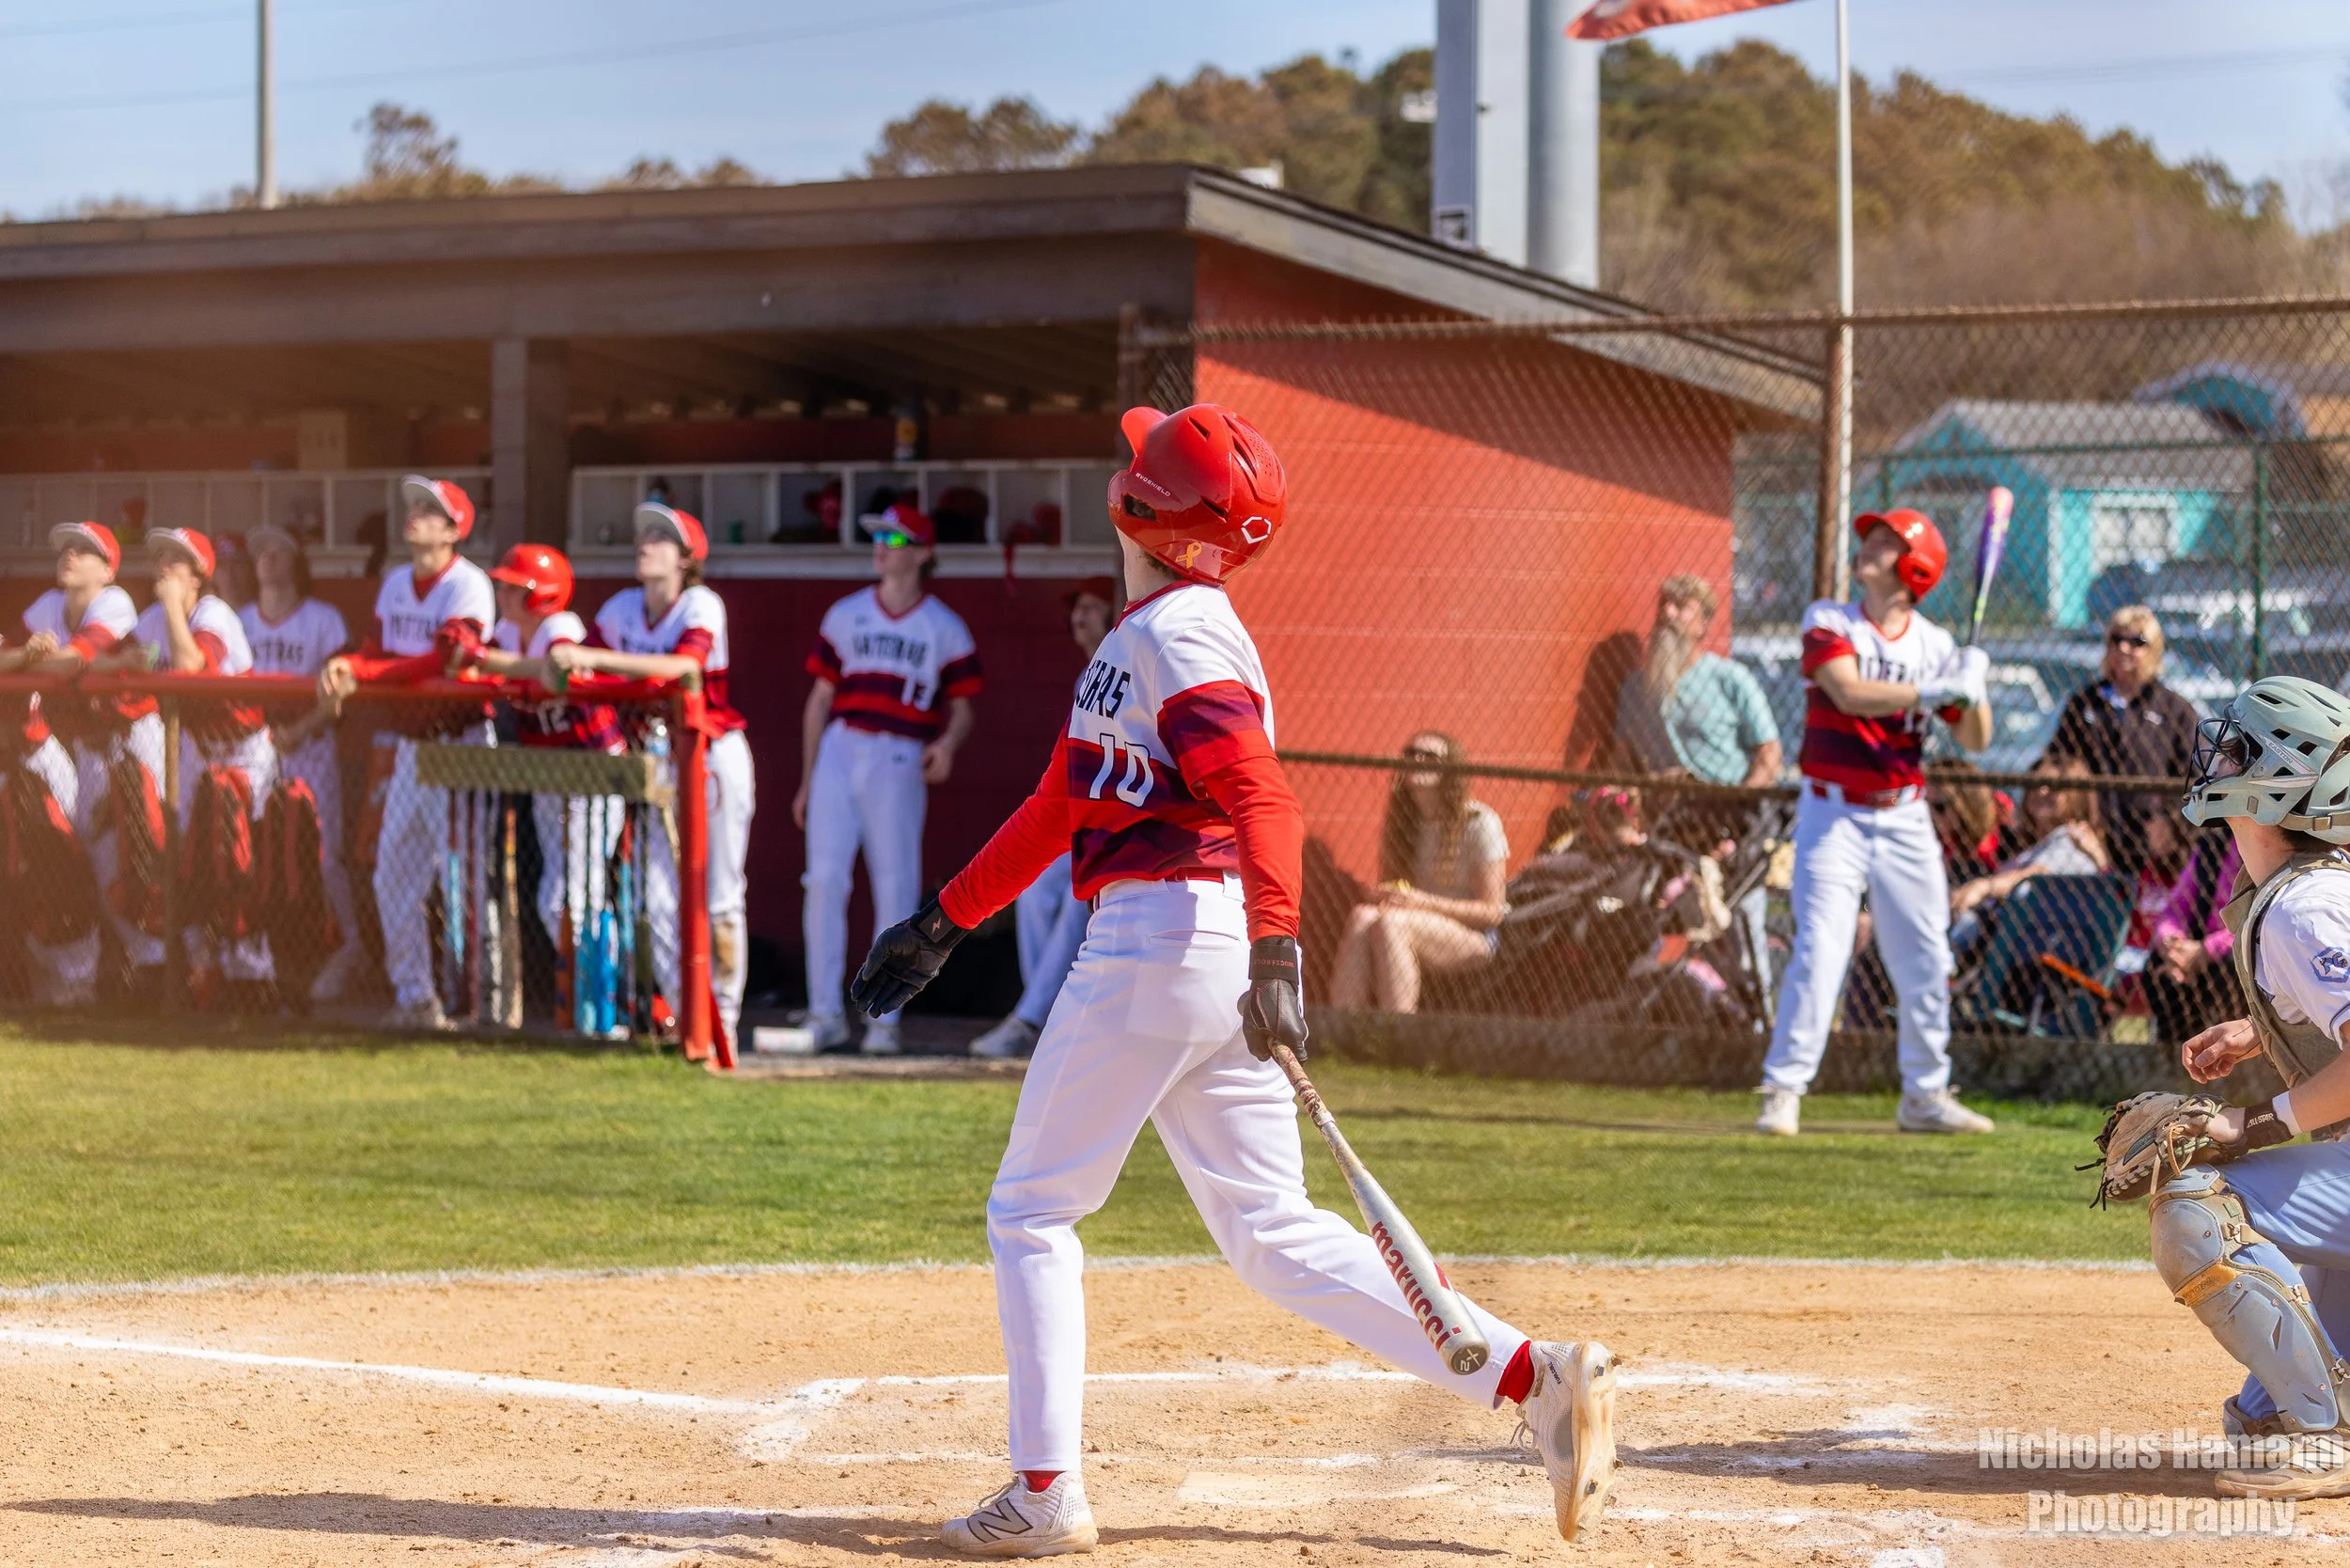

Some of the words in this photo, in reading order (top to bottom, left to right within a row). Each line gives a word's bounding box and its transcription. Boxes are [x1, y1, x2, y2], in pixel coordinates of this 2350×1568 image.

[901, 675, 934, 713] 13
[1089, 732, 1154, 808] 10
[1371, 1221, 1461, 1352] marucci
